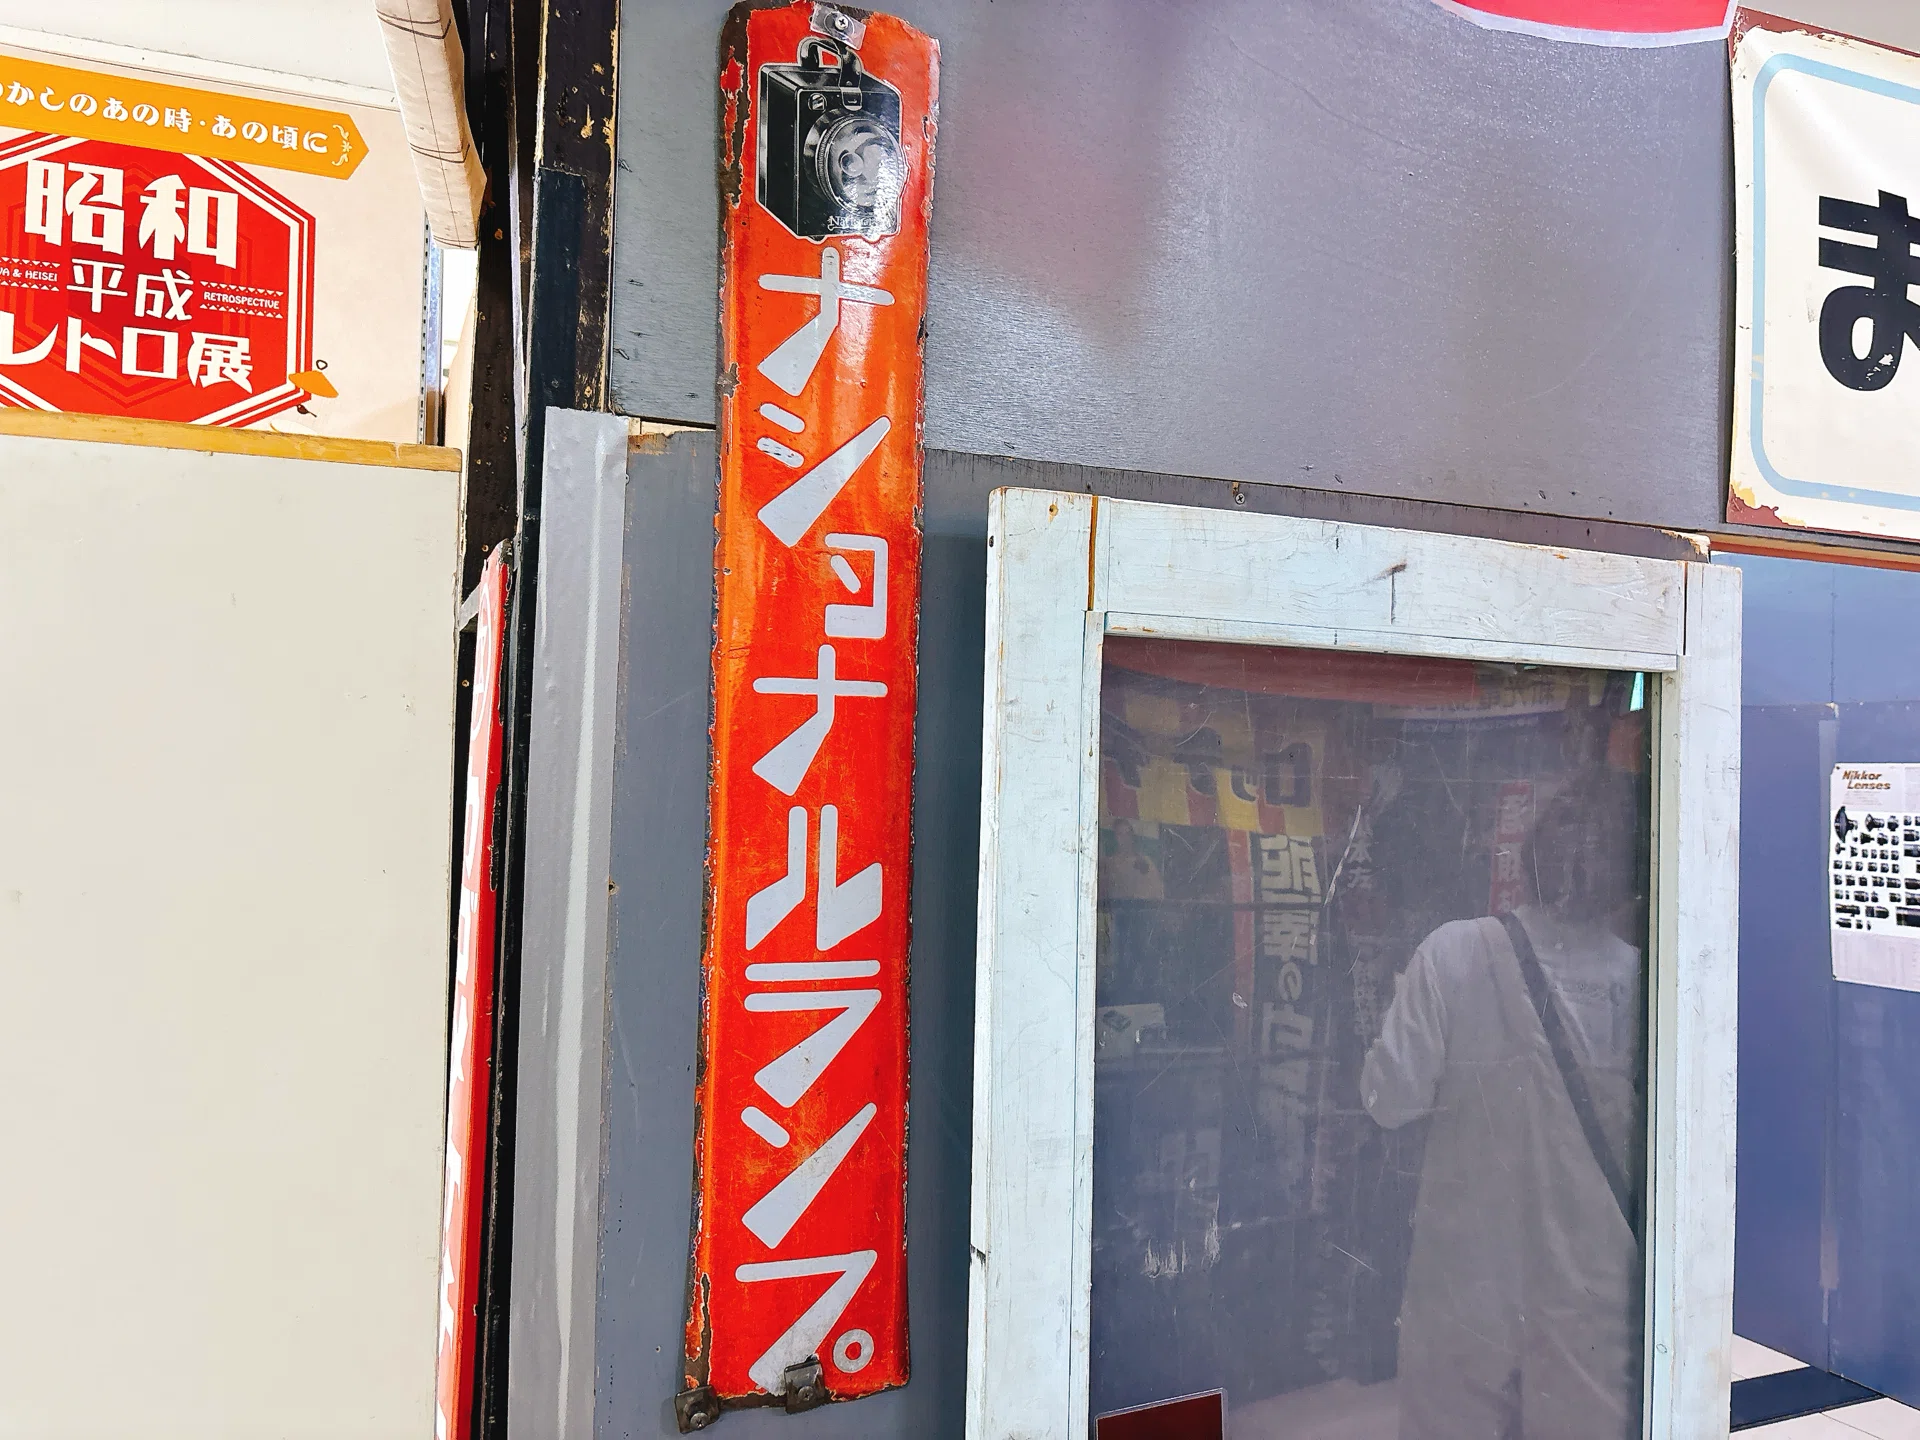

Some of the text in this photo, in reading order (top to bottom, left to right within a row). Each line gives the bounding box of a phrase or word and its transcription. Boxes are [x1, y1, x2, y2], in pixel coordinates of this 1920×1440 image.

[0, 80, 330, 154] かしのあの時・あの頃に
[24, 159, 239, 270] 昭和
[12, 268, 22, 278] &
[25, 270, 58, 282] HEISEI
[66, 258, 194, 321] 平成
[203, 291, 280, 310] RETROSPECTIVE
[0, 310, 253, 394] レトロ展
[1842, 770, 1883, 780] Nikkor
[1847, 780, 1891, 790] Lenses
[735, 246, 895, 1397] ナショナルランプ
